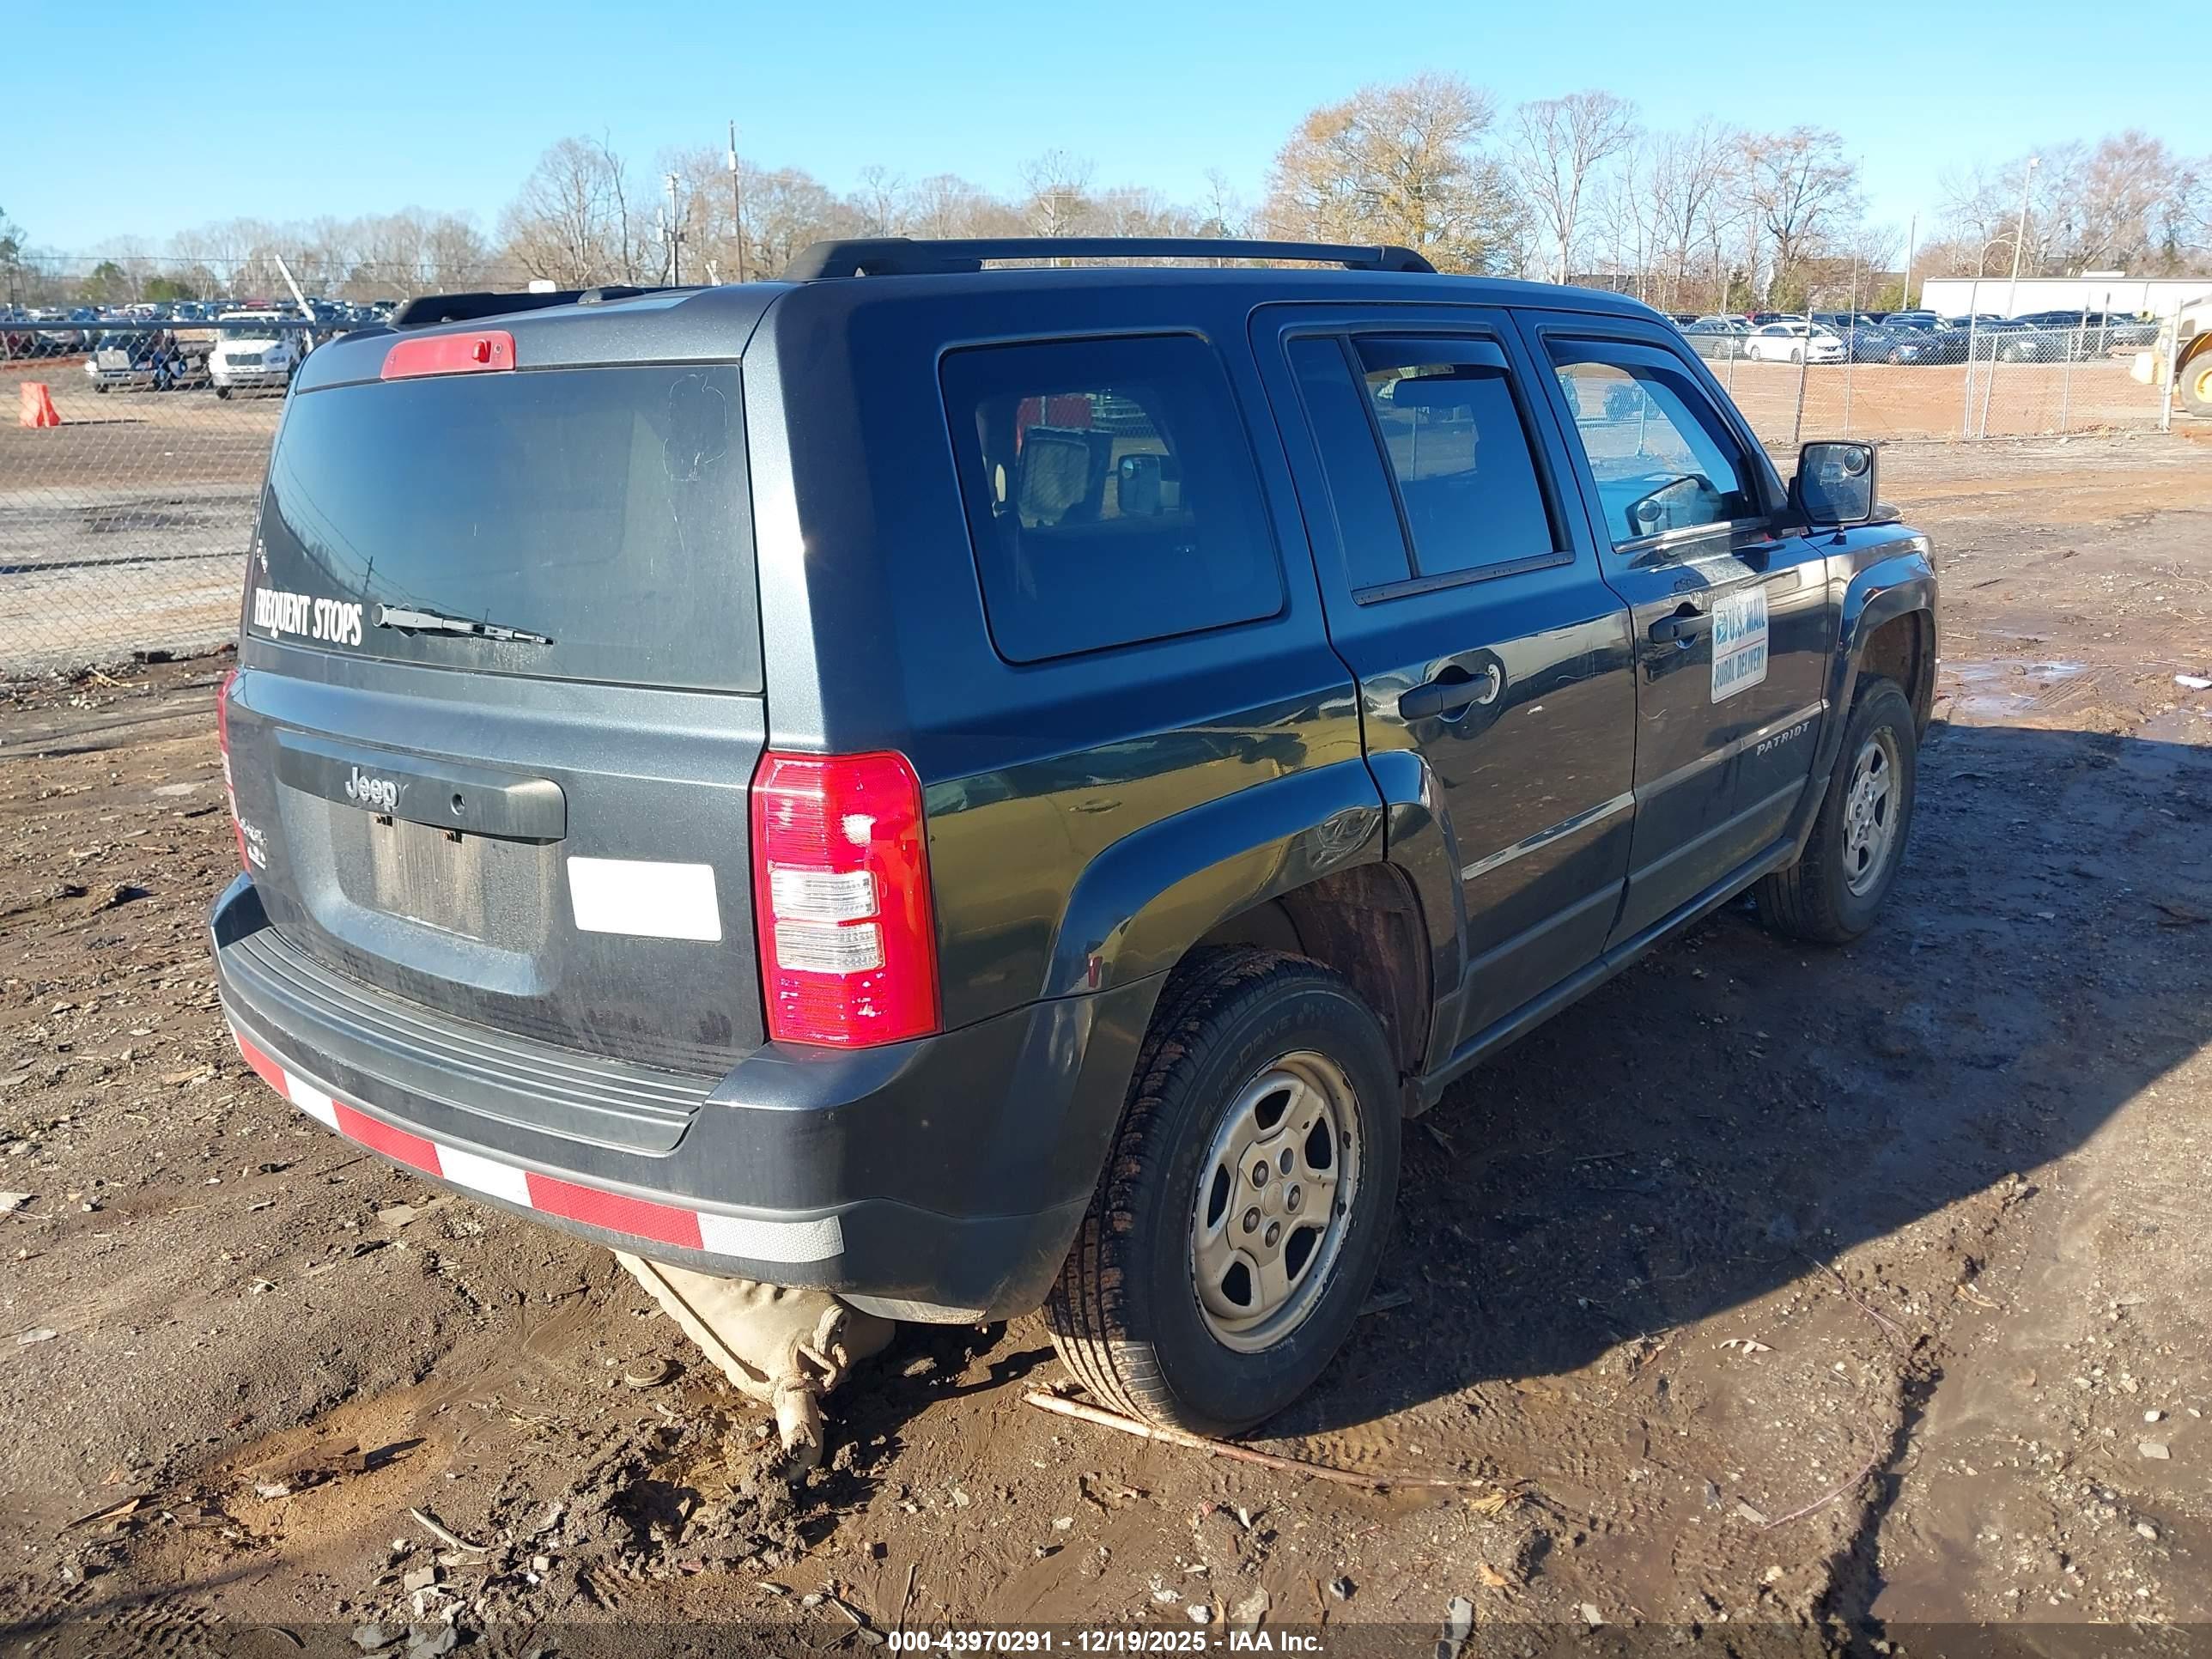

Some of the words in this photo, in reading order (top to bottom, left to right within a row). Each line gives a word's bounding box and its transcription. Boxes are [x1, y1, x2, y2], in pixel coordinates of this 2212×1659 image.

[254, 587, 311, 639] FREQUENT
[313, 598, 362, 647] STOPS
[1746, 597, 1765, 634] MAIL
[1715, 656, 1735, 690] RURAL
[1736, 644, 1765, 679] DELIVERY
[1757, 720, 1810, 757] PATRIOT
[345, 766, 399, 812] Jeep
